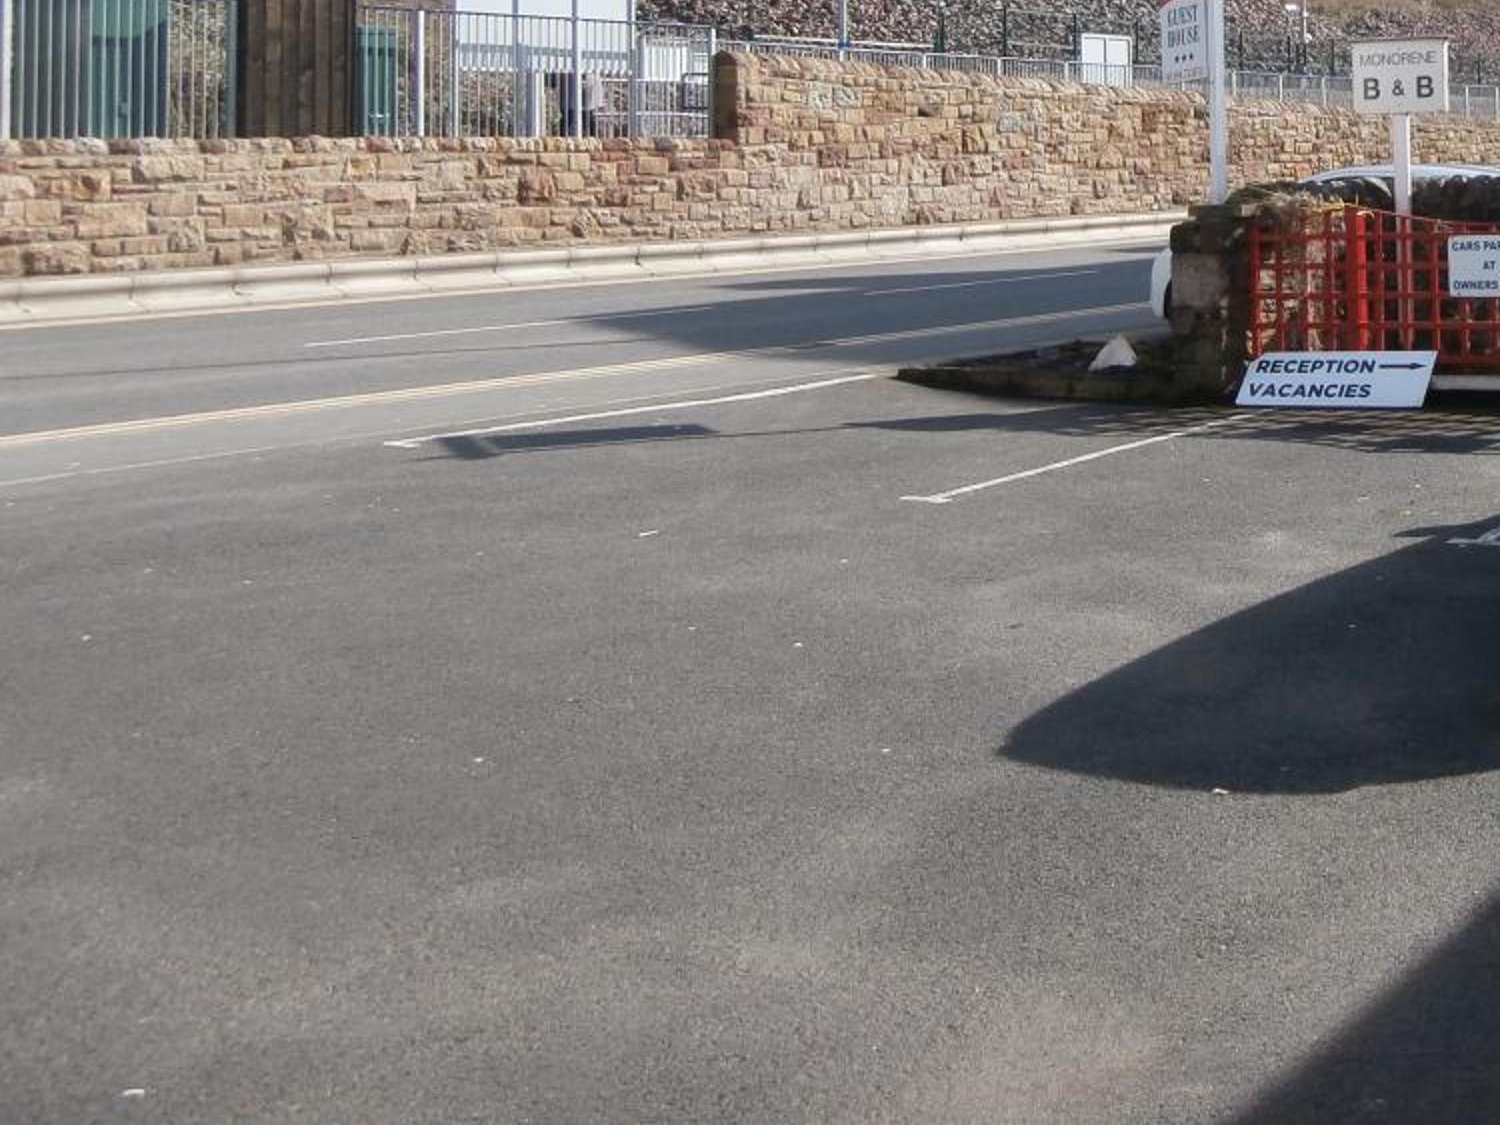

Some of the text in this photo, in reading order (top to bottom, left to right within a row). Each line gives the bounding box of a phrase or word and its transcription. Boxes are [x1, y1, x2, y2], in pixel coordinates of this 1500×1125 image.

[1359, 51, 1438, 67] MONORENE
[1363, 76, 1435, 99] B & B
[1452, 240, 1481, 252] CARS
[1483, 260, 1495, 271] AT
[1453, 280, 1499, 291] OWNERS
[1255, 359, 1377, 374] RECEPTION
[1248, 383, 1372, 398] VACANCIES
